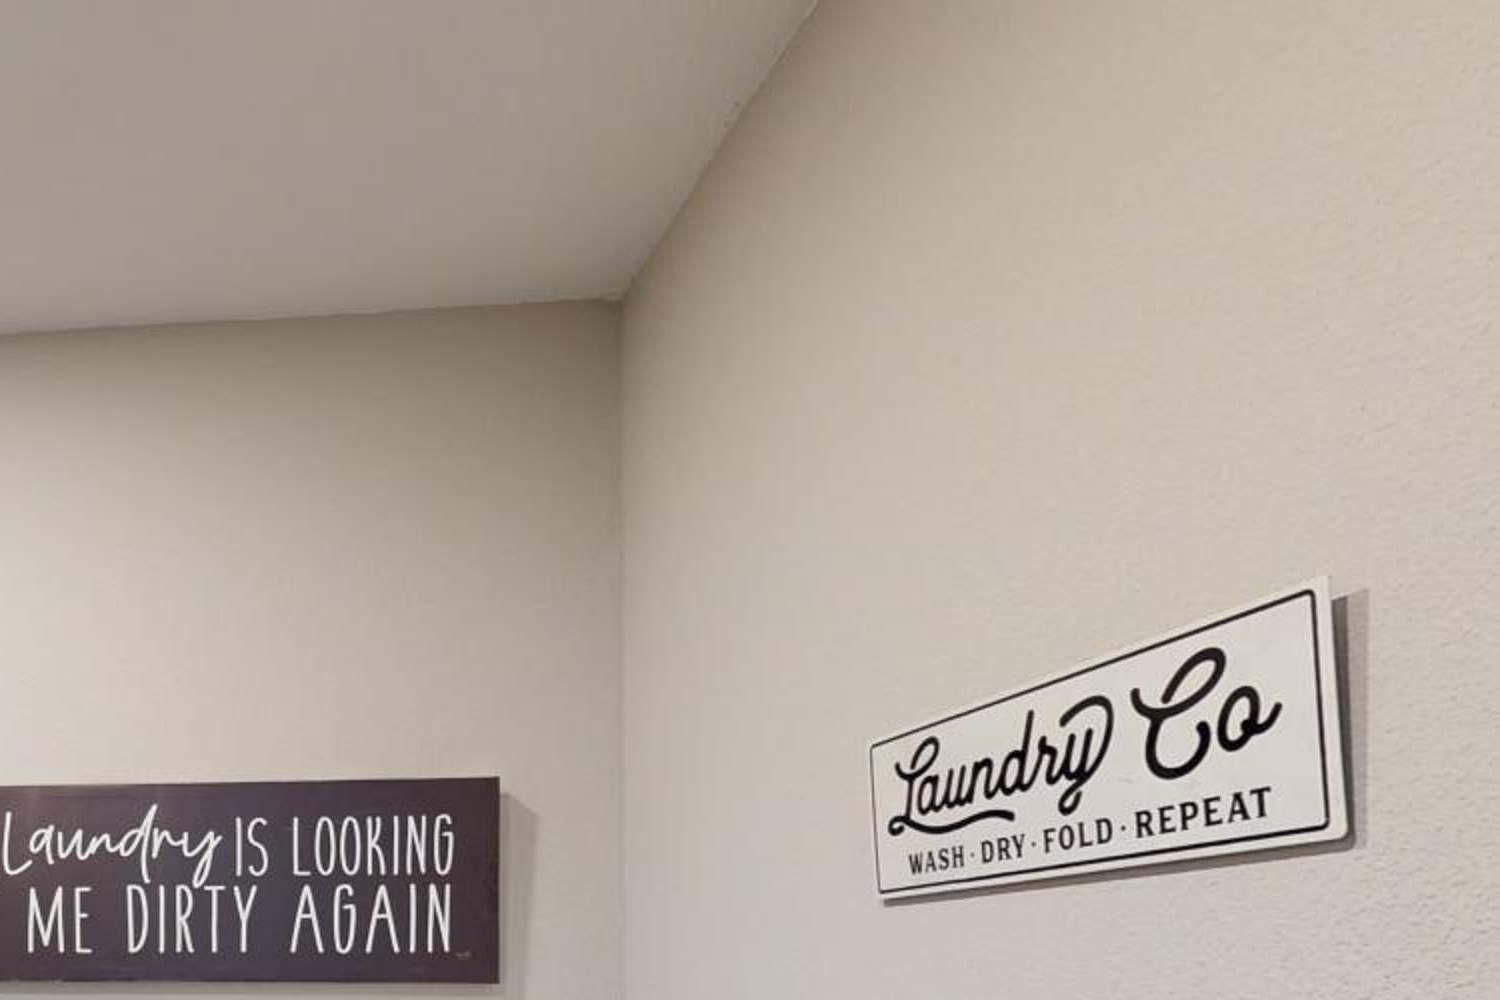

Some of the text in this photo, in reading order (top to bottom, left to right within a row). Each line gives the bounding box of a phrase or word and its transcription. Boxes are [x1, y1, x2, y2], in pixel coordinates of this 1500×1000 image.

[888, 646, 1283, 836] Laundry Co
[2, 803, 223, 888] Laundry
[235, 815, 269, 877] IS
[292, 812, 455, 877] LOOKING
[908, 785, 1272, 876] WASH DRY FOLD REPEAT
[27, 884, 94, 953] ME
[126, 884, 258, 954] DIRTY
[290, 883, 451, 955] AGAIN
